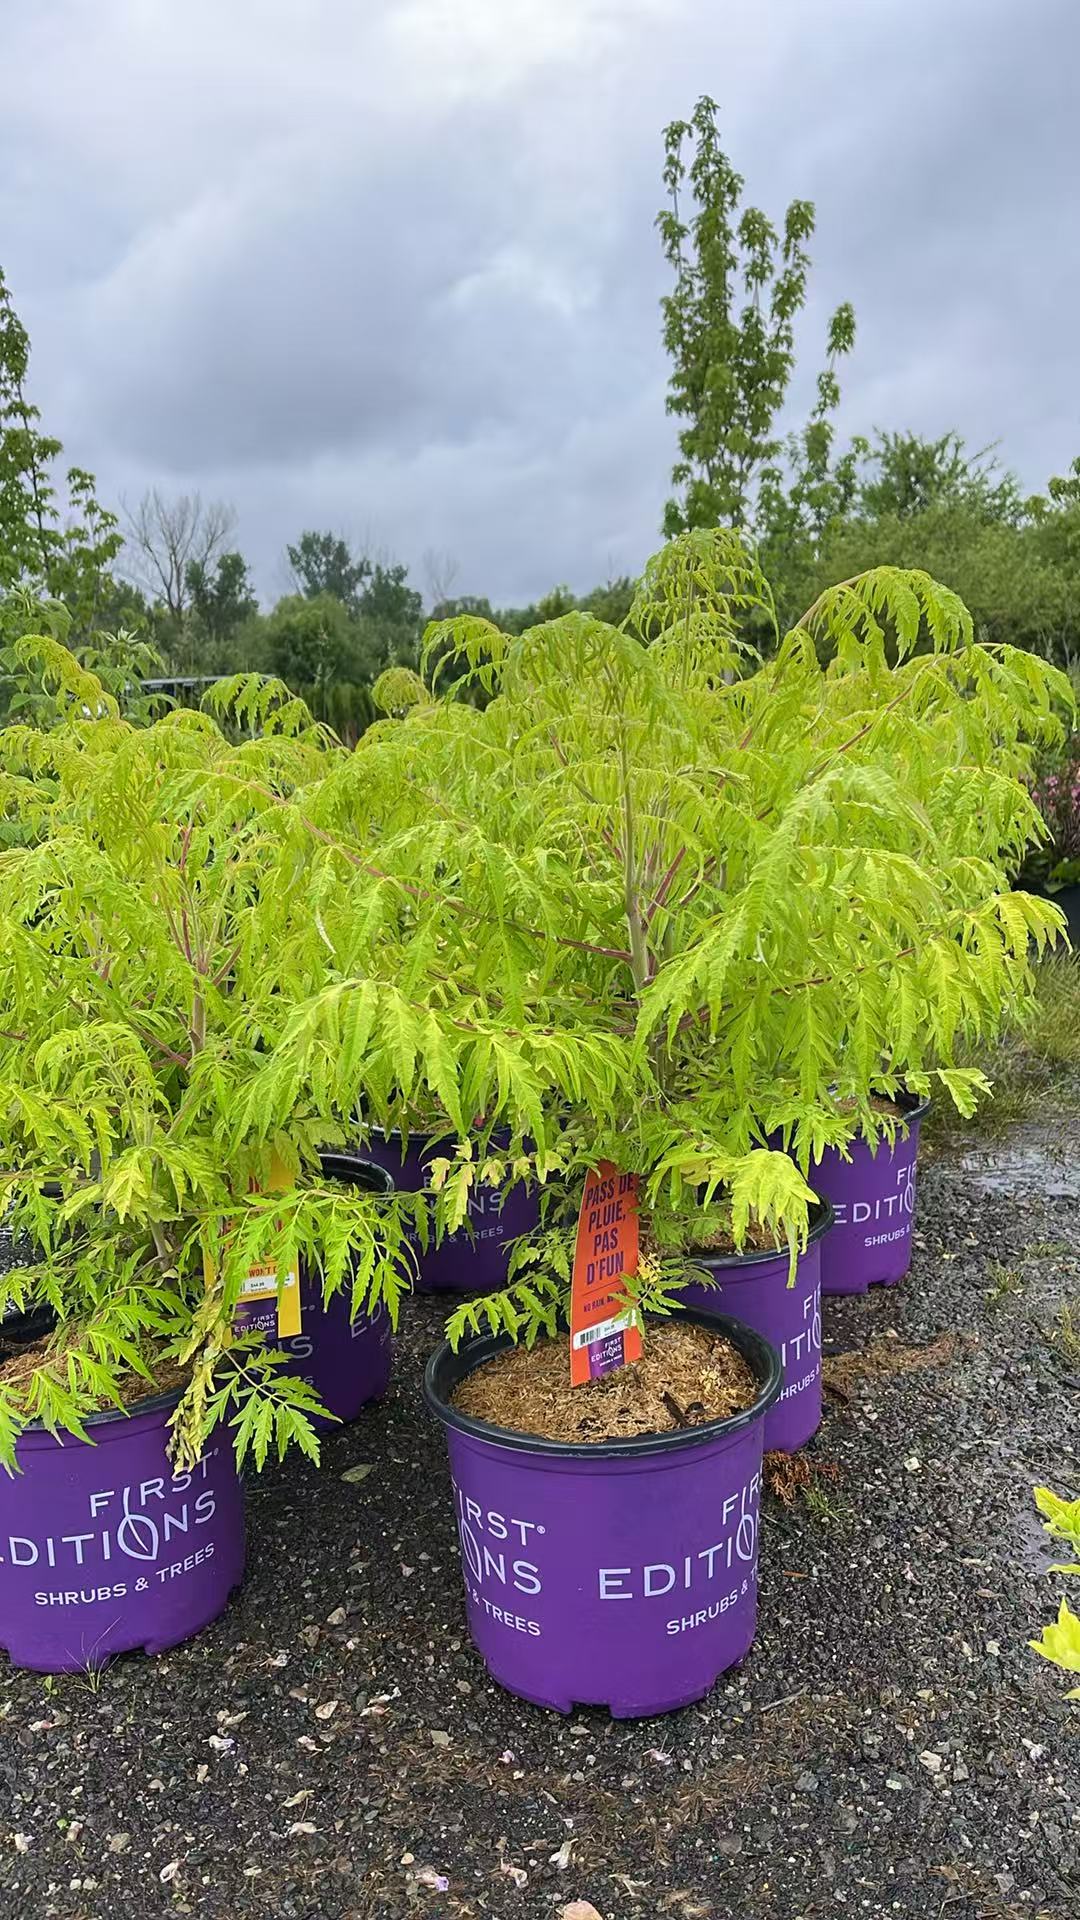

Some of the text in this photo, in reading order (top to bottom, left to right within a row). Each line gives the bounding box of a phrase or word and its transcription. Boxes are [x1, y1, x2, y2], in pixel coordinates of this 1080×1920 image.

[585, 1172, 634, 1210] PASS DE
[462, 1225, 504, 1242] TREES
[588, 1200, 626, 1233] PLUIE,
[593, 1227, 619, 1256] PAS
[864, 1227, 905, 1247] SHRUBS
[586, 1251, 624, 1286] D'FUN
[234, 1320, 276, 1333] EDITIONS
[252, 1313, 275, 1322] FIRST
[591, 1344, 622, 1362] EDITIONS
[605, 1336, 622, 1349] FIRST
[781, 1311, 821, 1367] ITIO
[0, 1489, 217, 1567] DITIONS
[458, 1517, 542, 1595] ONS
[34, 1542, 215, 1606] SHRUBS & TREES
[481, 1597, 541, 1636] TREES
[666, 1578, 749, 1635] SHRUBS &
